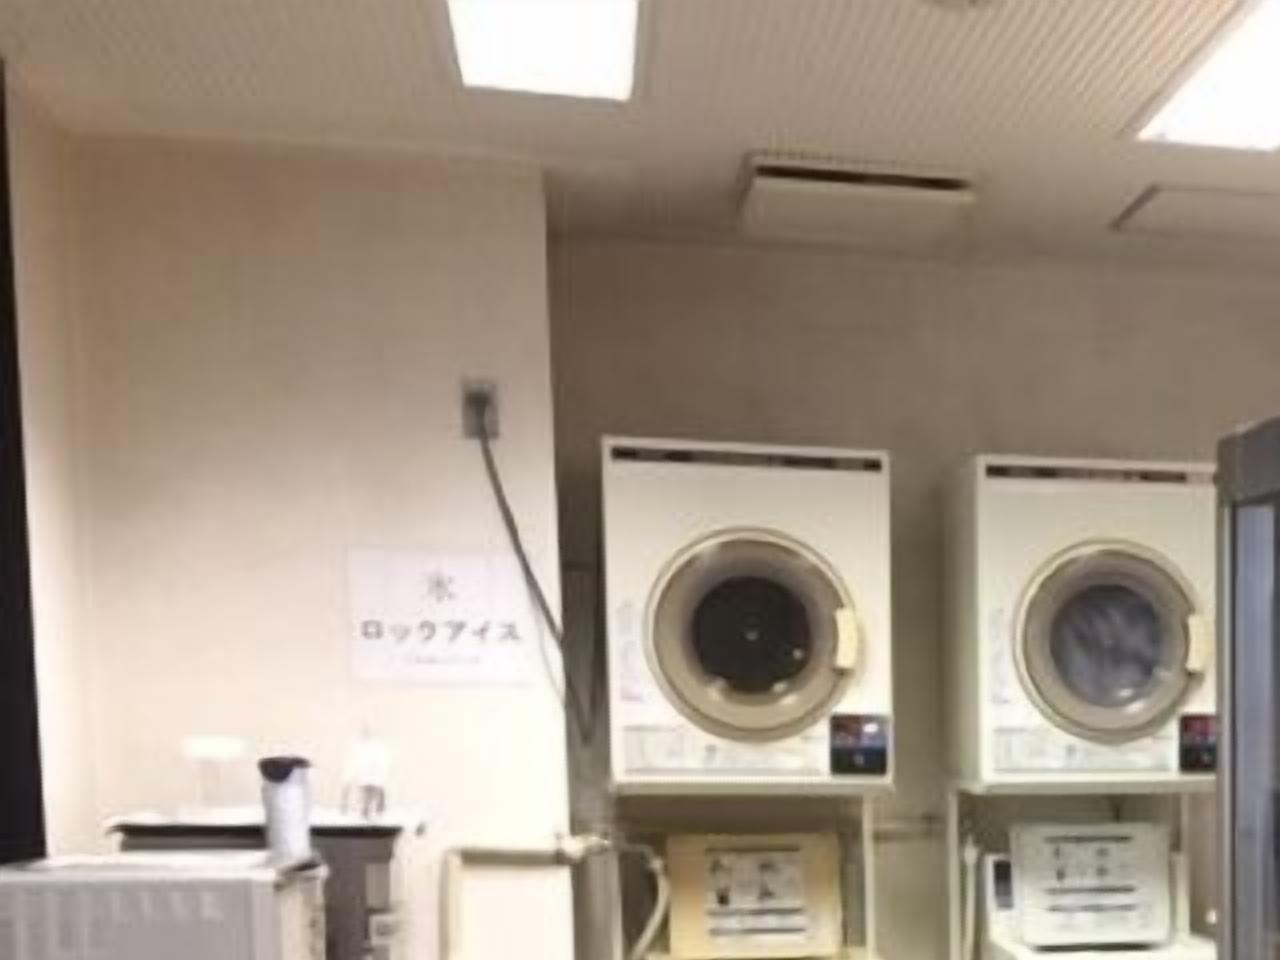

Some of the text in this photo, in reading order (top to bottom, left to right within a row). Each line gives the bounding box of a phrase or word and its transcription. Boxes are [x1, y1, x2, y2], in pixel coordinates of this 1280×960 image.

[359, 618, 522, 644] ロックアイス
